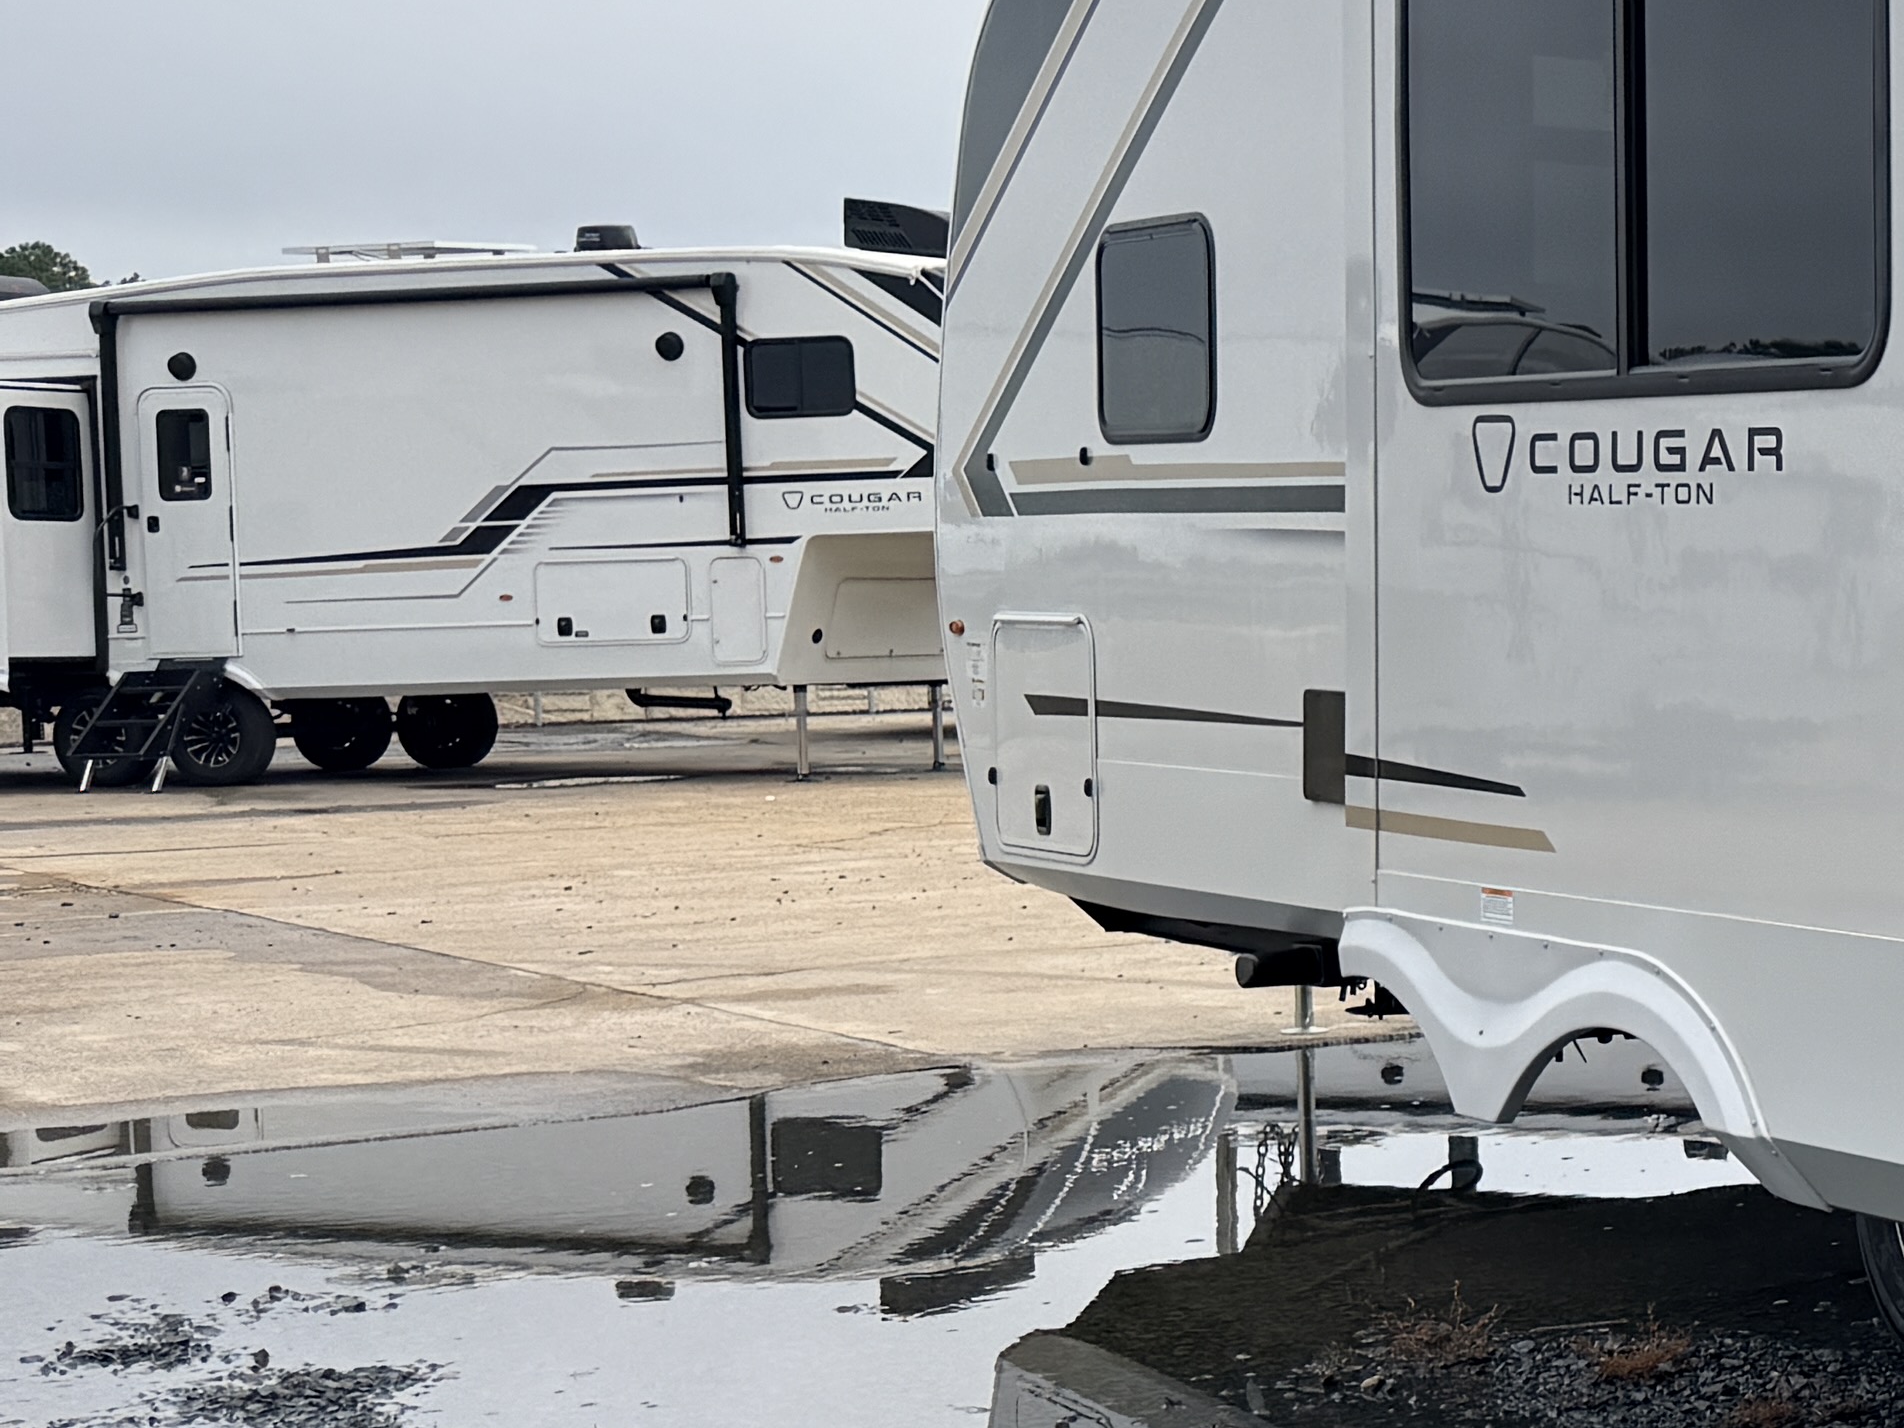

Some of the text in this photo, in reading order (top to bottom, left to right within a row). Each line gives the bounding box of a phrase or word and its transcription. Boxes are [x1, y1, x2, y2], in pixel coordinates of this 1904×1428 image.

[1529, 427, 1784, 474] COUGAR
[810, 491, 923, 505] COUGAR
[1567, 482, 1715, 507] HALF-TON
[823, 504, 891, 514] HALF-TON
